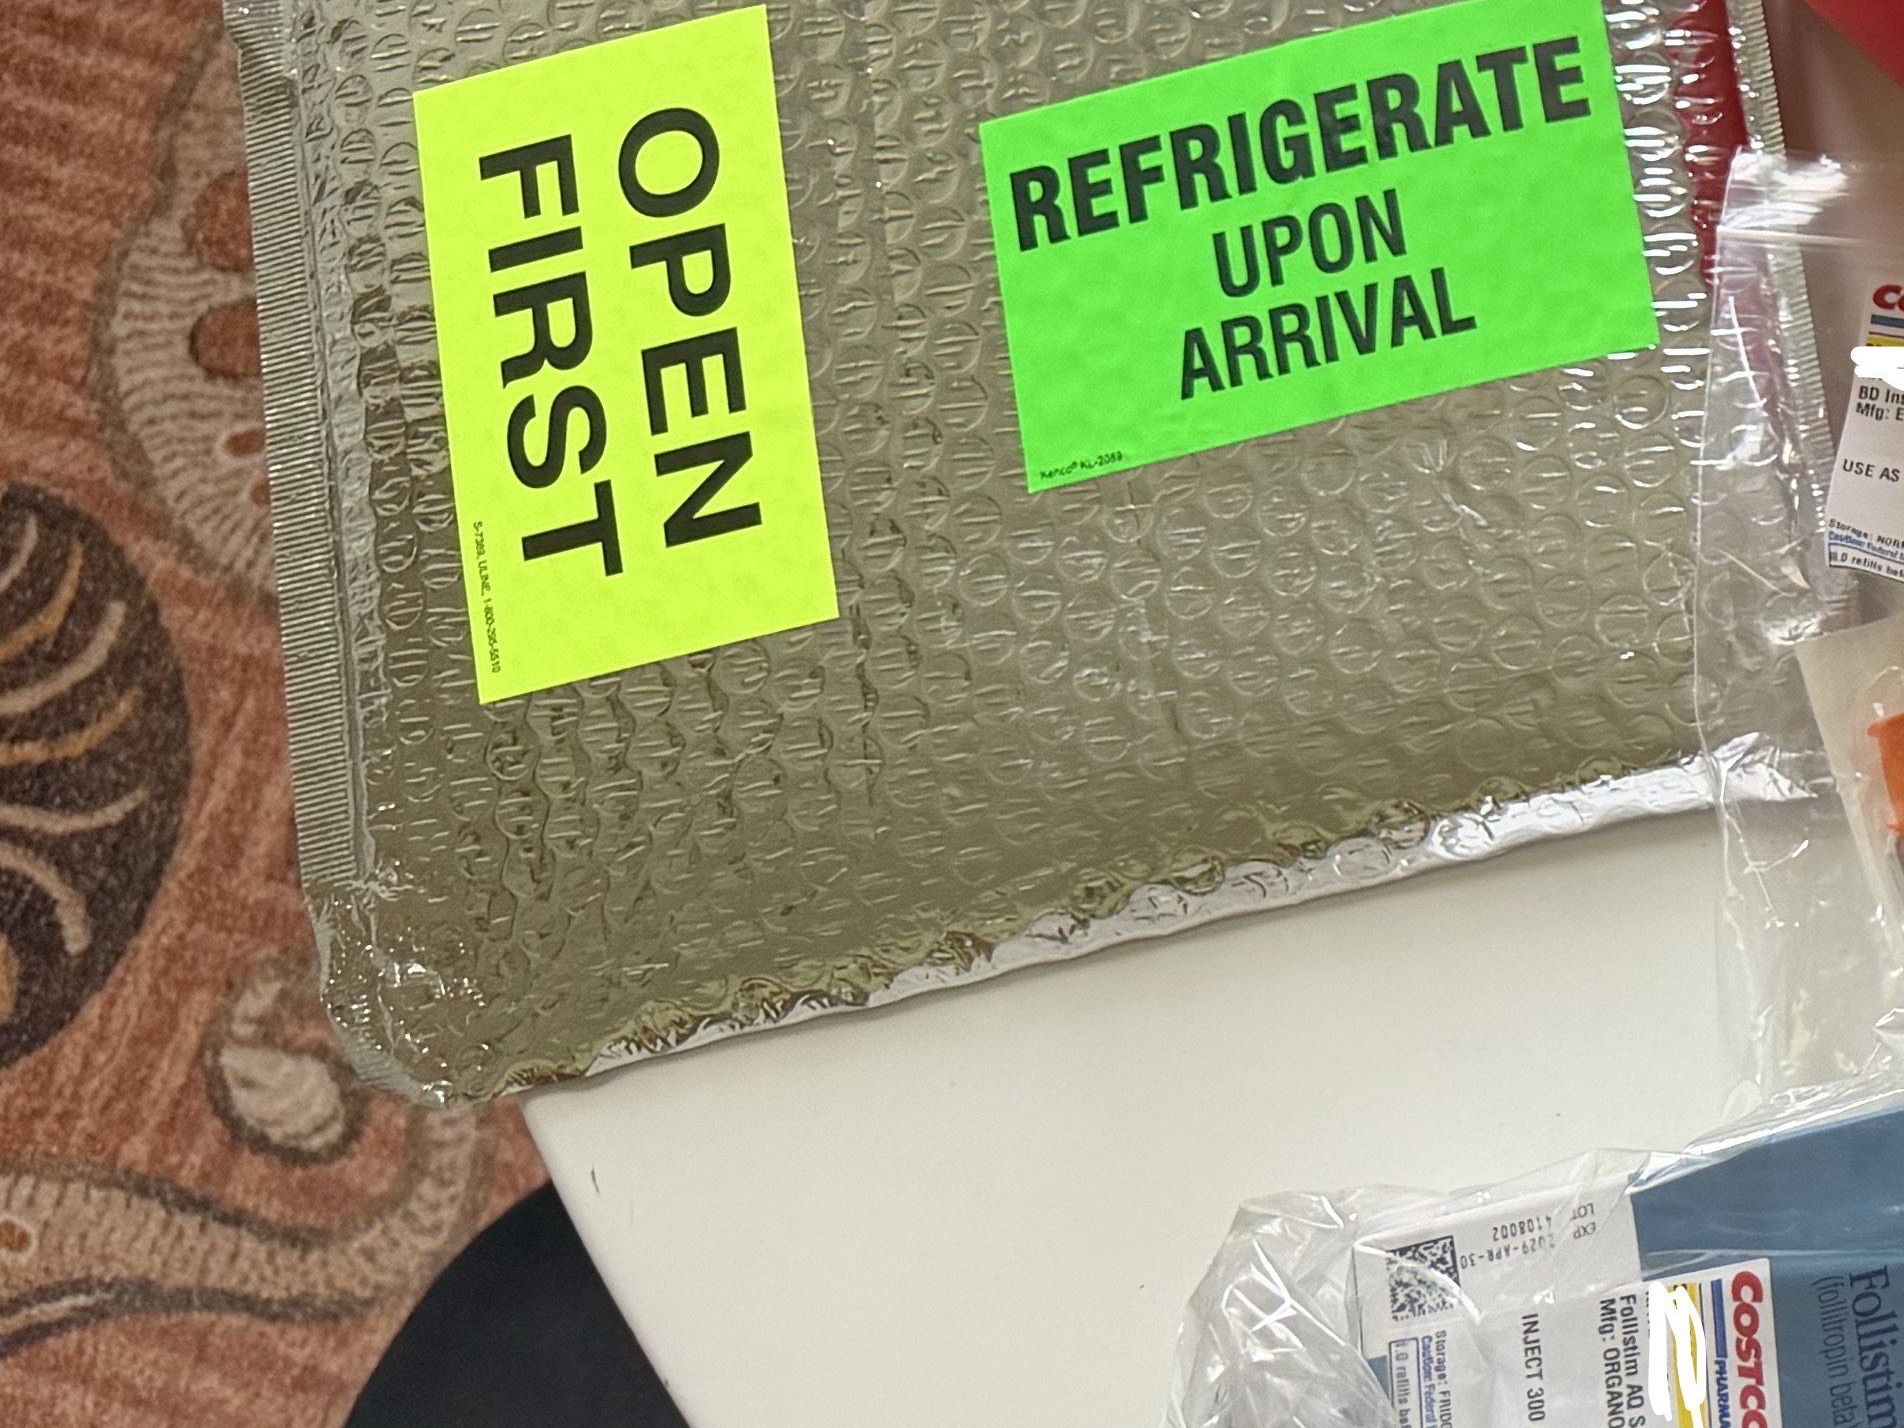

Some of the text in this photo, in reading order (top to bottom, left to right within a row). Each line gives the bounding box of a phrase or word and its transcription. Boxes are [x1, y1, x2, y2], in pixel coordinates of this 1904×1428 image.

[1009, 35, 1592, 252] REFRIGERATE
[1212, 188, 1407, 298] UPON
[476, 132, 622, 577] FIRST
[616, 105, 766, 552] OPEN
[1180, 267, 1477, 401] ARRIVAL
[1842, 458, 1876, 478] USE
[1878, 467, 1901, 483] AS
[1521, 1313, 1544, 1380] INJECT
[1526, 1387, 1546, 1422] 300
